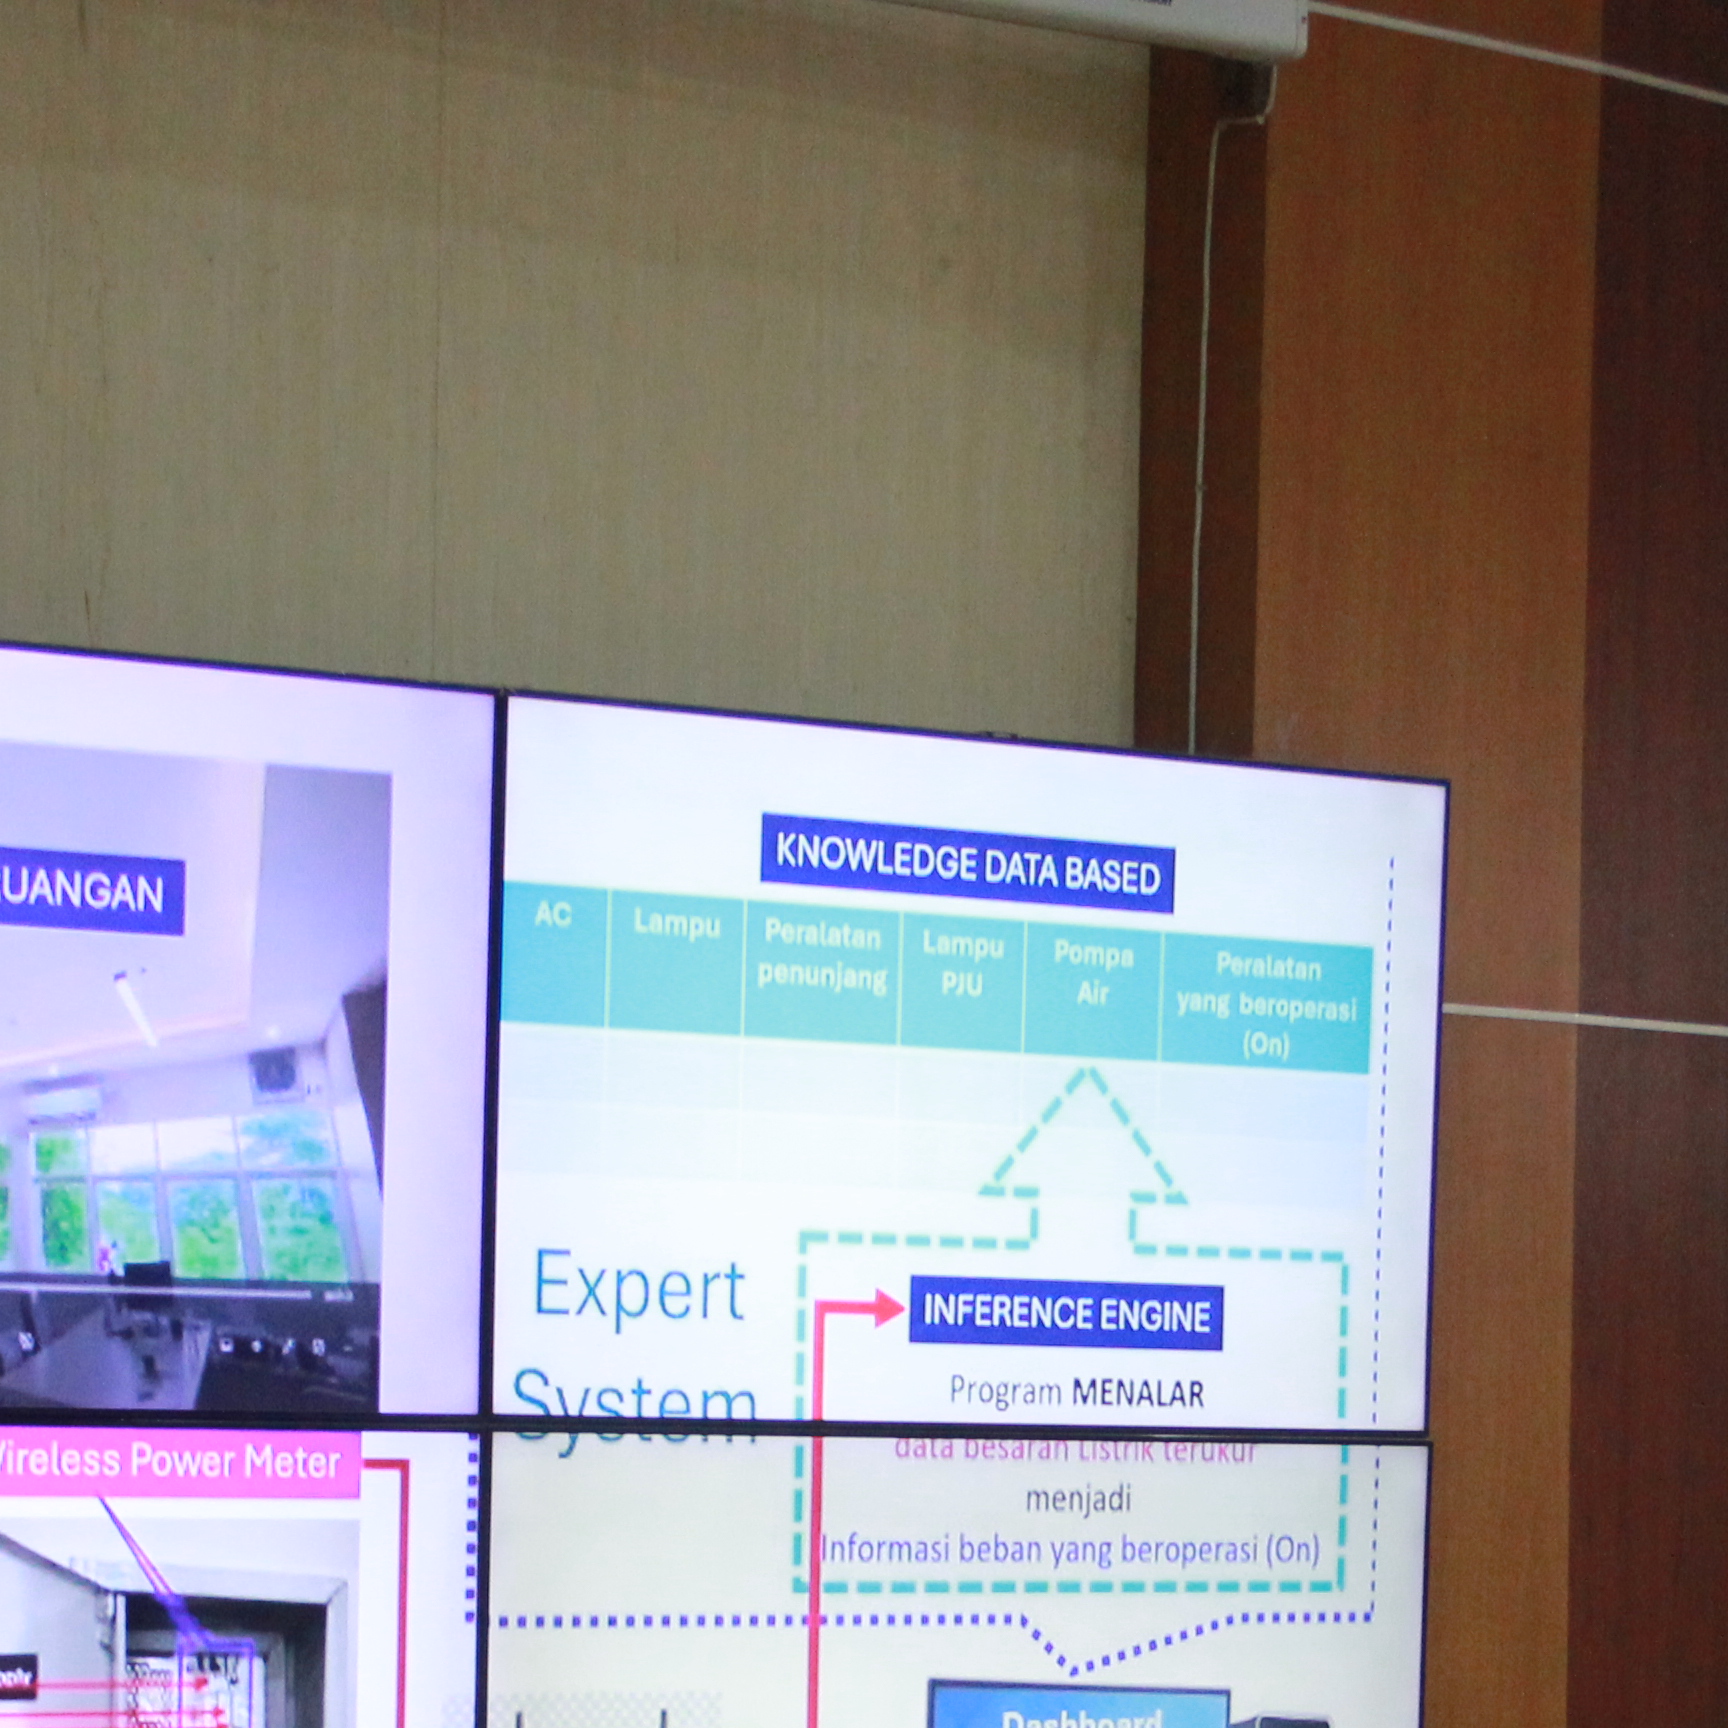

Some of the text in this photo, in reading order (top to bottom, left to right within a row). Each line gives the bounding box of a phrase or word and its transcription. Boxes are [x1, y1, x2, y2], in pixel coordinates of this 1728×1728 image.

[777, 832, 1161, 895] KNOWLEDGE DATA BASED
[535, 901, 571, 928] AC
[635, 907, 721, 942] Lampu
[766, 917, 881, 949] Peralatan
[923, 929, 1004, 961] Lampu
[1055, 939, 1134, 972] Pompa
[1217, 951, 1322, 982] Peralatan
[758, 962, 887, 997] penunjang
[943, 971, 983, 997] PJU
[1078, 980, 1109, 1005] Air
[1178, 990, 1357, 1023] yang beroperasi
[1243, 1031, 1290, 1061] (On)
[536, 1248, 745, 1335] Expert
[924, 1293, 1211, 1333] INFERENCE ENGINE
[951, 1374, 1205, 1411] Program MENALAR
[514, 1368, 756, 1459] System
[132, 1441, 235, 1478] Power
[244, 1443, 341, 1478] Meter
[895, 1438, 954, 1459] data
[965, 1438, 1069, 1461] besaran
[1163, 1442, 1255, 1463] terukur
[1026, 1482, 1131, 1520] menjadi
[821, 1532, 1320, 1569] Informasi beban yang beroperasi (On)
